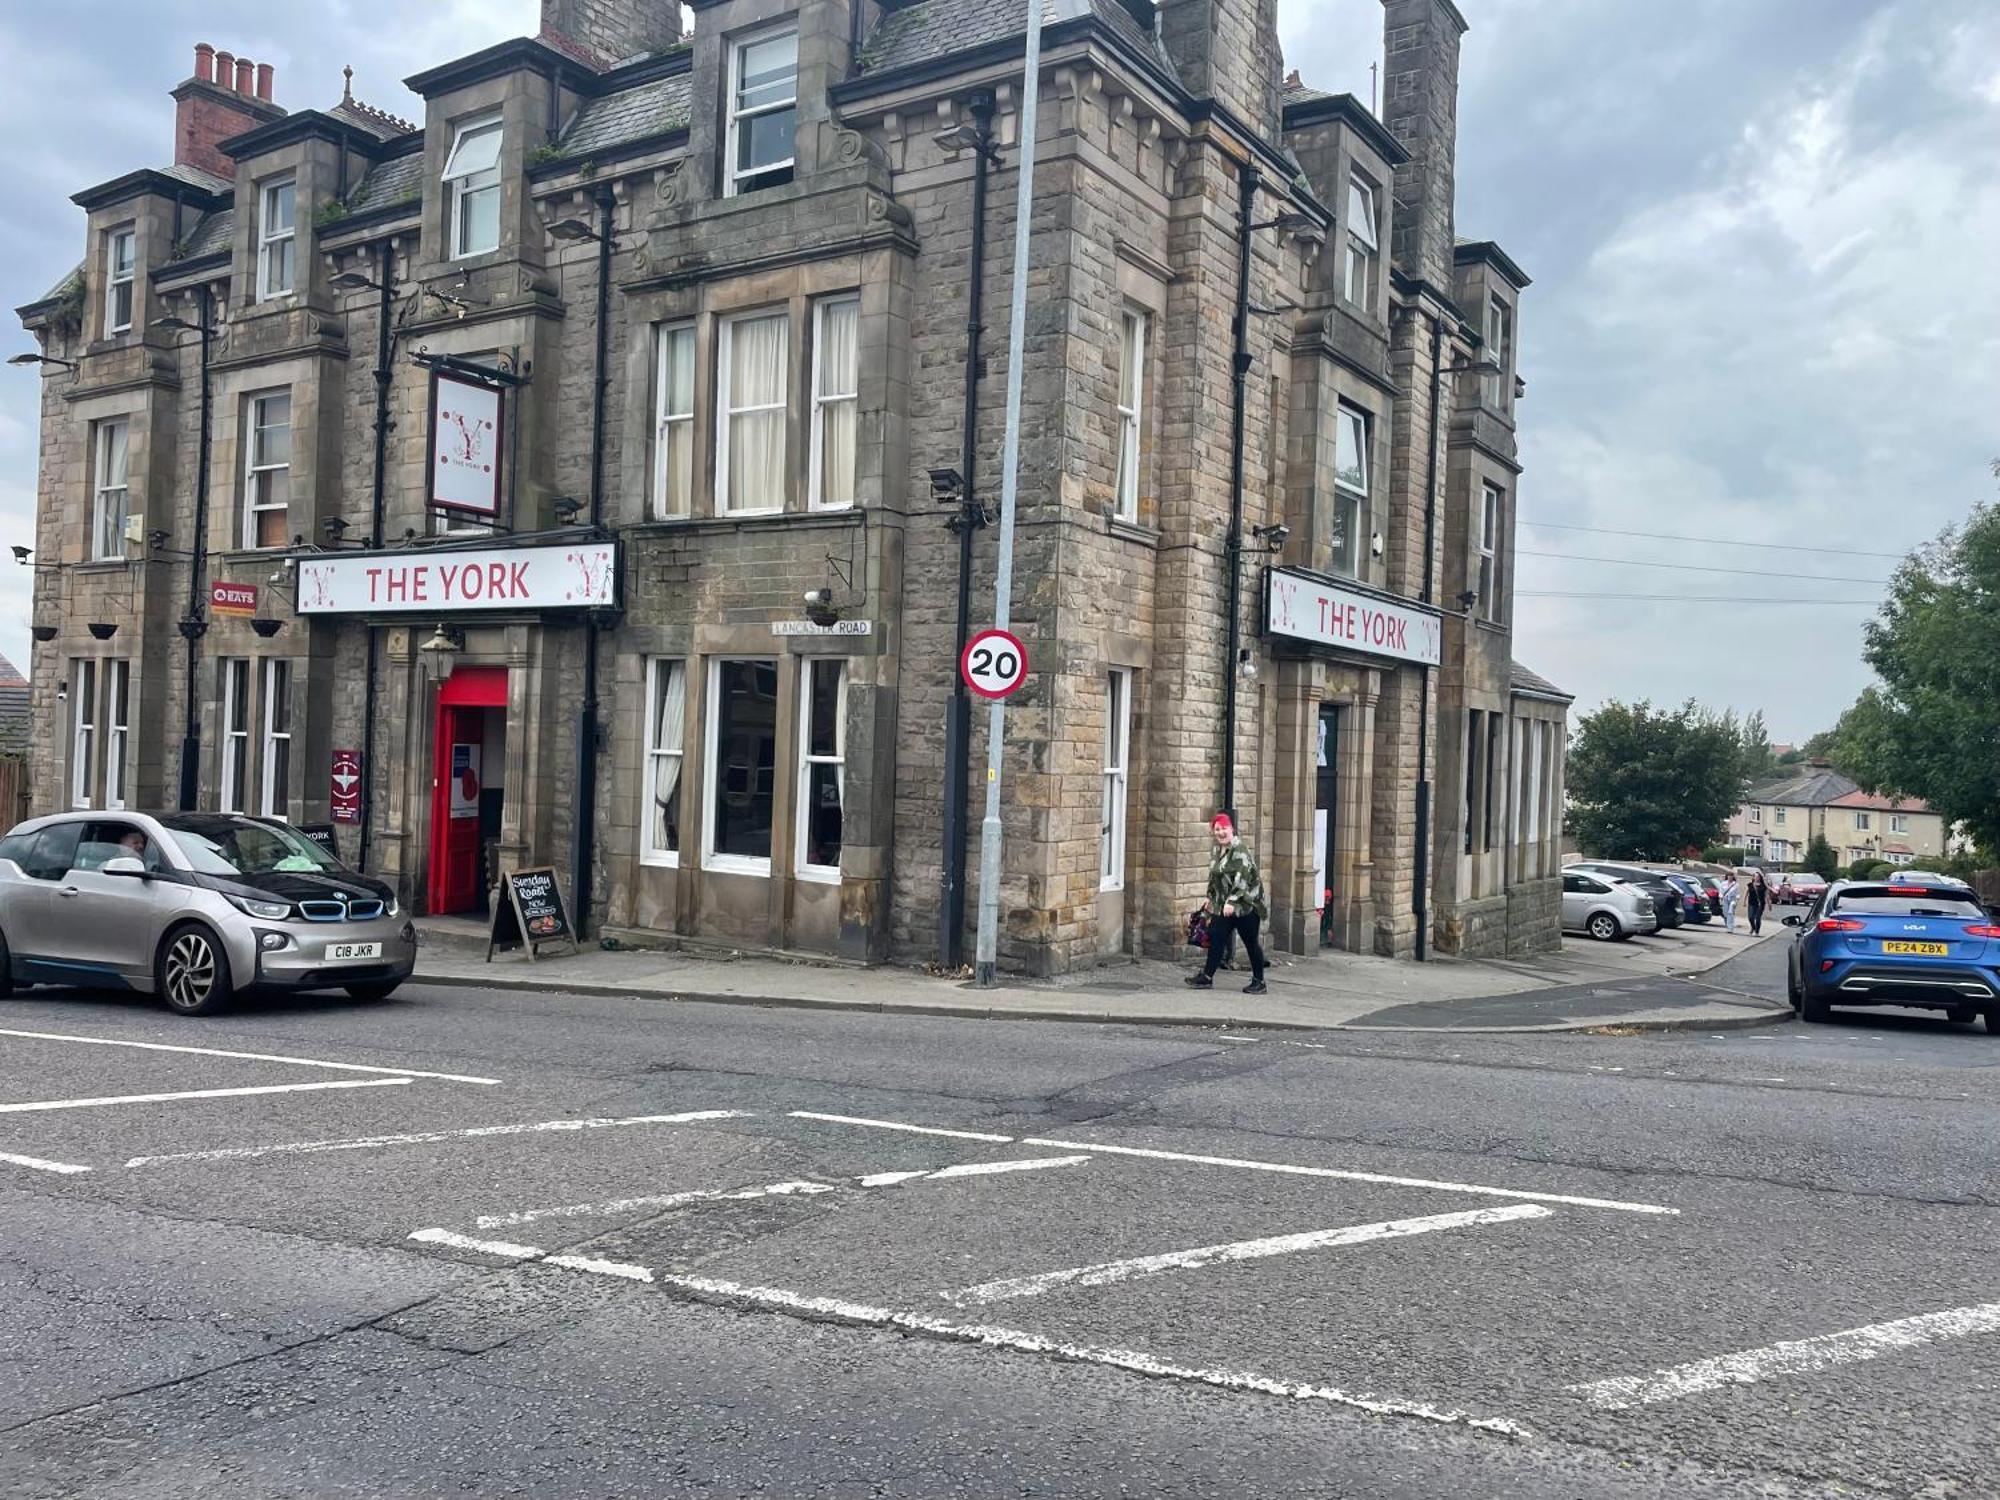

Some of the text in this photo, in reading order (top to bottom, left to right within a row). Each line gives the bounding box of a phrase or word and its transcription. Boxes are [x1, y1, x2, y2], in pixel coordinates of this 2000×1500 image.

[366, 561, 530, 602] THE YORK
[227, 593, 254, 603] EATS
[839, 622, 867, 633] ROAD
[1318, 597, 1407, 651] THE YORK
[971, 648, 1017, 679] 20
[512, 874, 551, 889] Sunday
[519, 886, 547, 900] Roast
[335, 944, 373, 957] C18 JKR
[1887, 942, 1943, 954] PE24 ZBX
